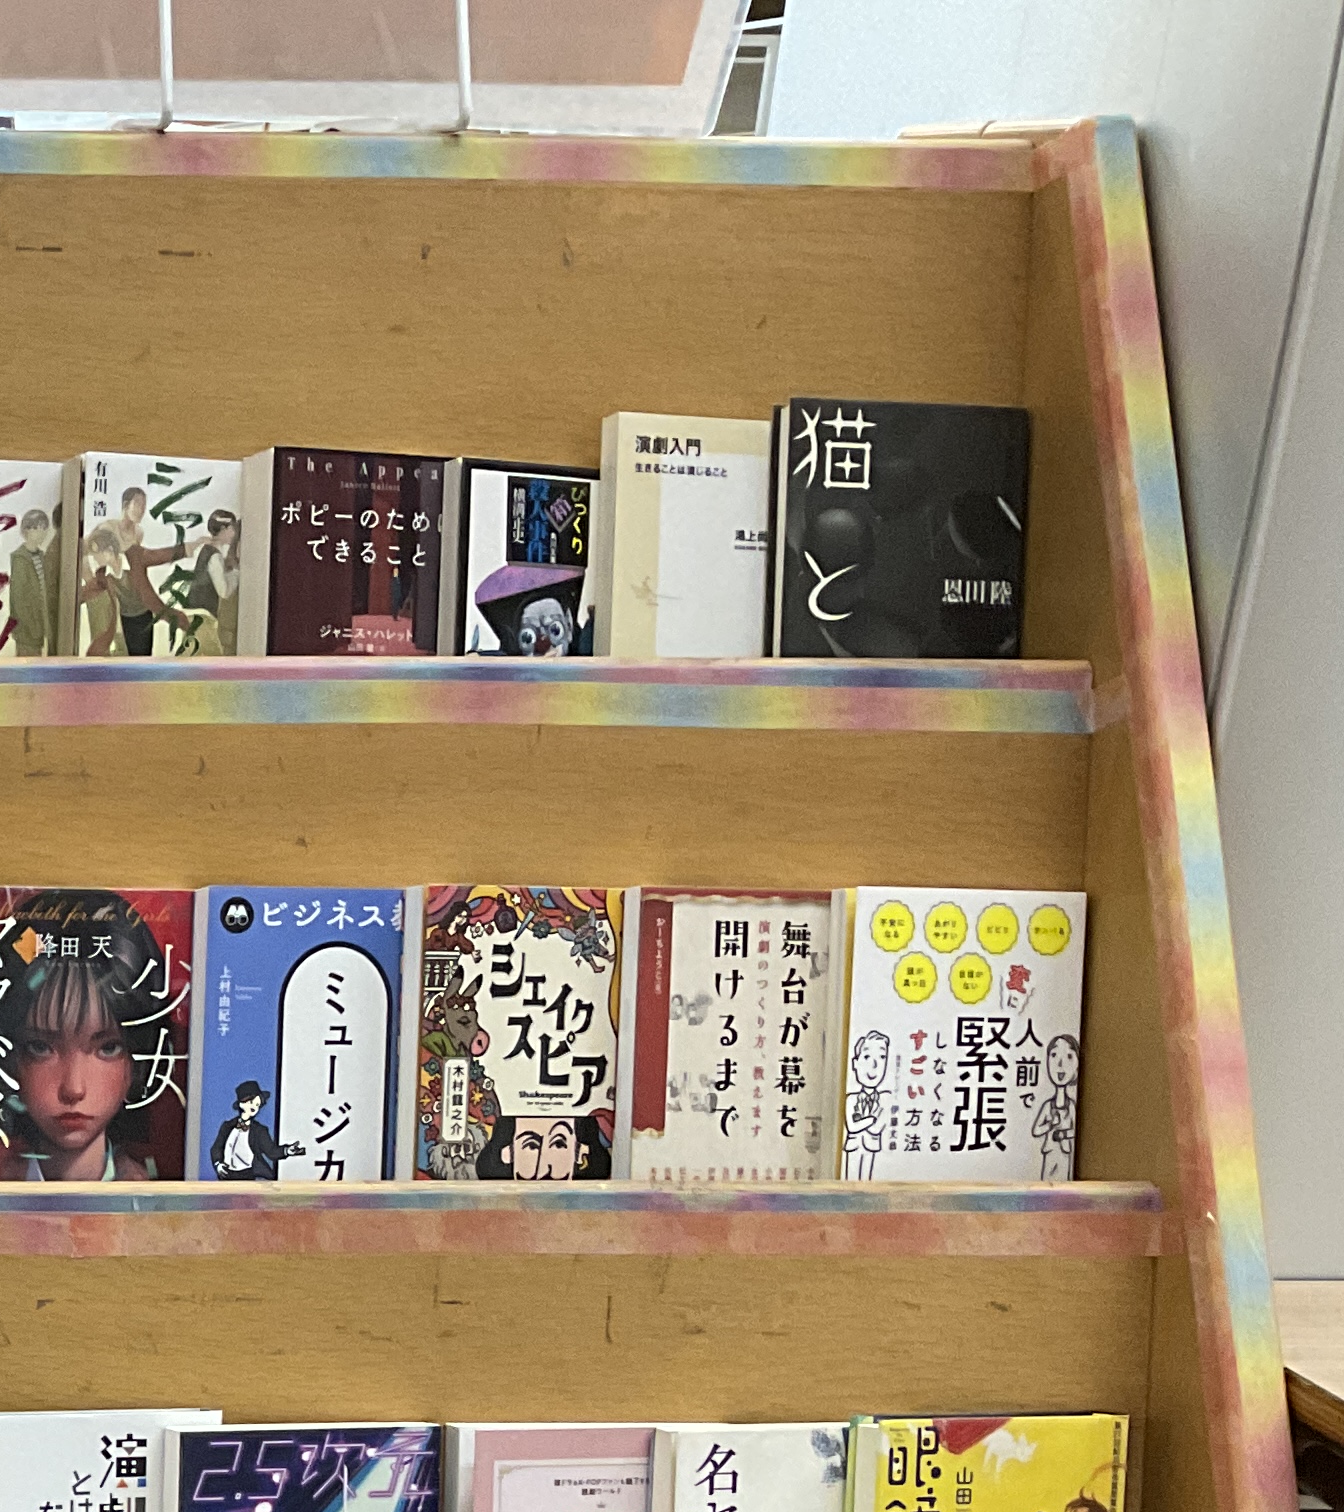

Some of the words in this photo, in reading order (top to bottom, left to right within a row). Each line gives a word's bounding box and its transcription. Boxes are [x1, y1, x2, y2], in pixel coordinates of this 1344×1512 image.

[360, 461, 440, 482] Appea
[635, 435, 701, 457] 演劇入門
[306, 535, 428, 567] できること
[121, 942, 191, 1110] 少女
[714, 919, 749, 1138] 開けるまで
[774, 919, 811, 1138] 舞台が幕を
[950, 1016, 1011, 1152] 緊張
[1015, 1017, 1043, 1109] 人前で
[903, 1029, 928, 1152] すごい方法
[929, 1031, 947, 1152] しなくなる
